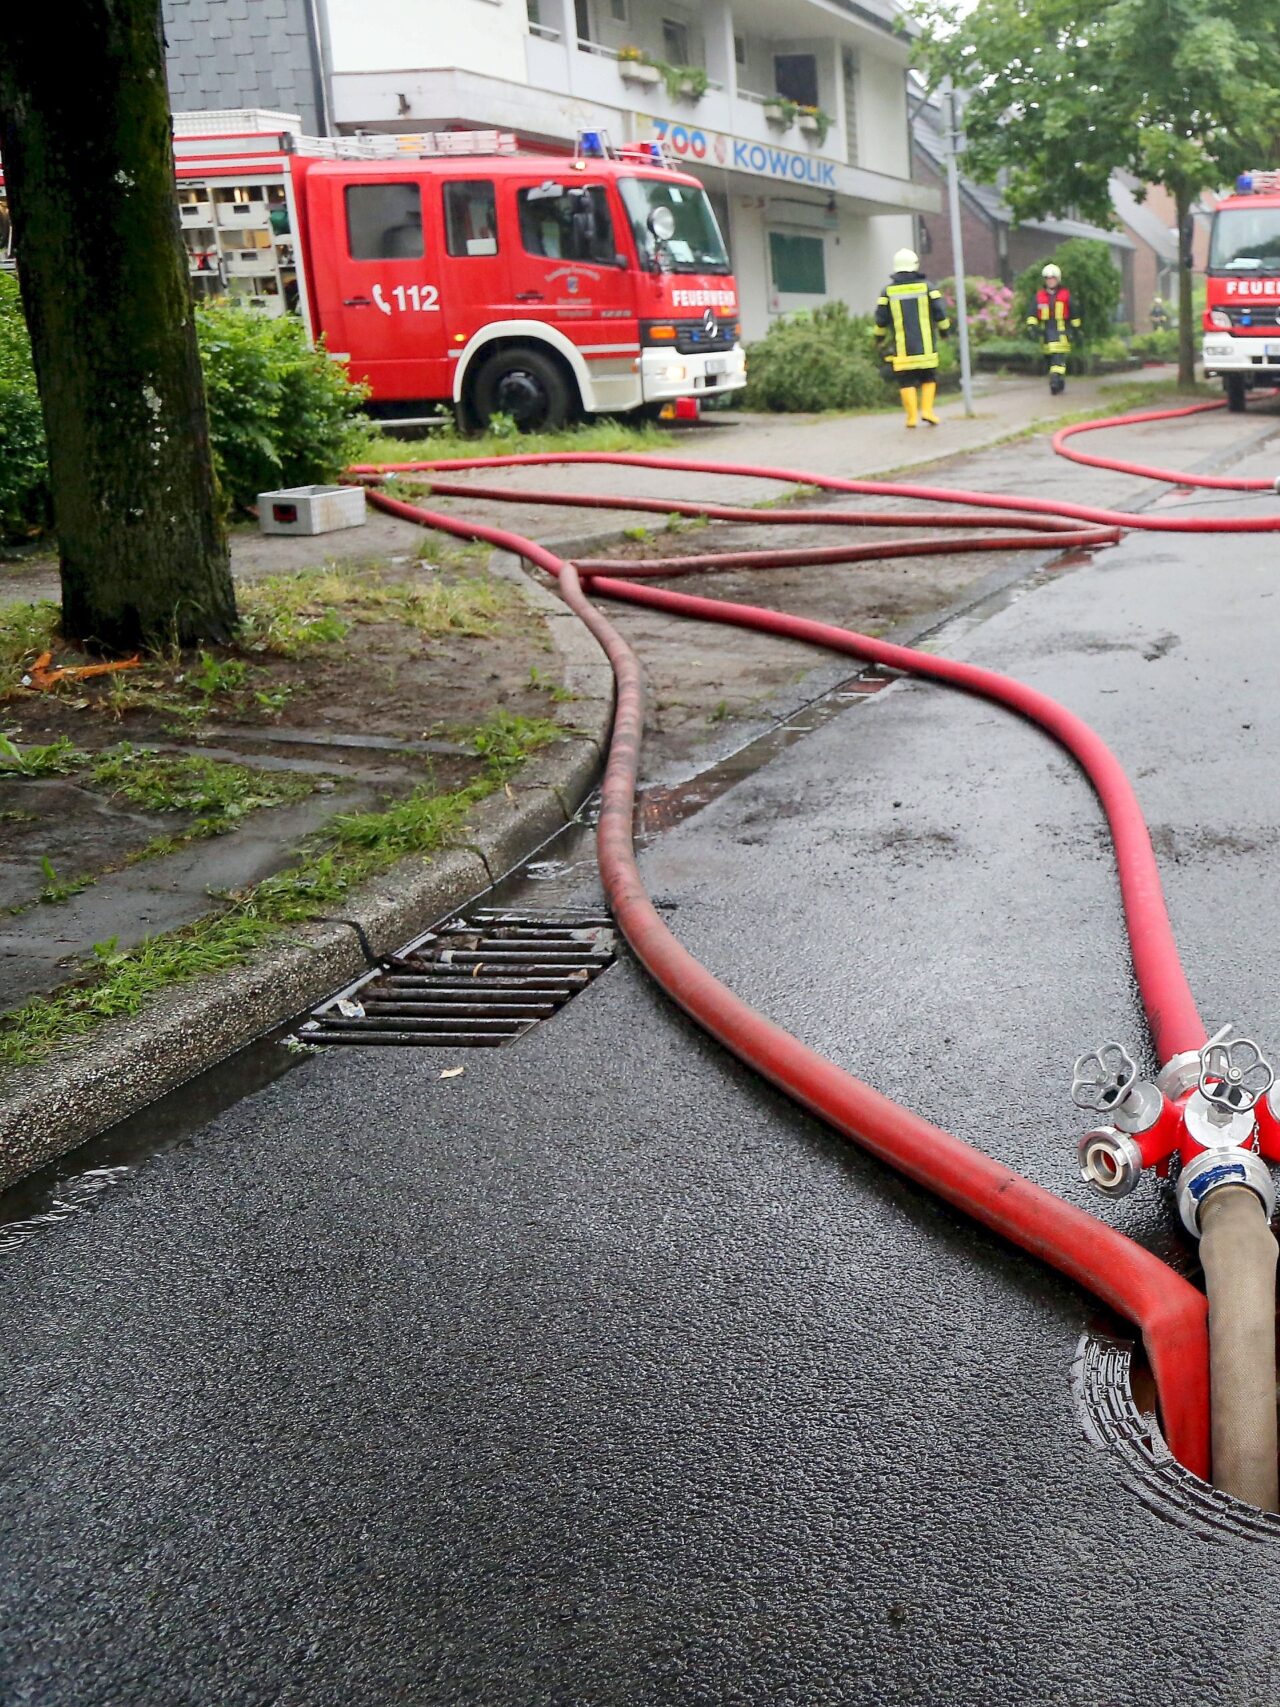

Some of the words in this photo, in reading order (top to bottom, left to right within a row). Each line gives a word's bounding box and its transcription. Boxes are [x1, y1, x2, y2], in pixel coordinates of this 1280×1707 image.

[652, 119, 706, 159] ZOO
[733, 140, 836, 187] KOWOLIK
[392, 284, 440, 312] 112
[671, 289, 736, 307] FEUERWEHR
